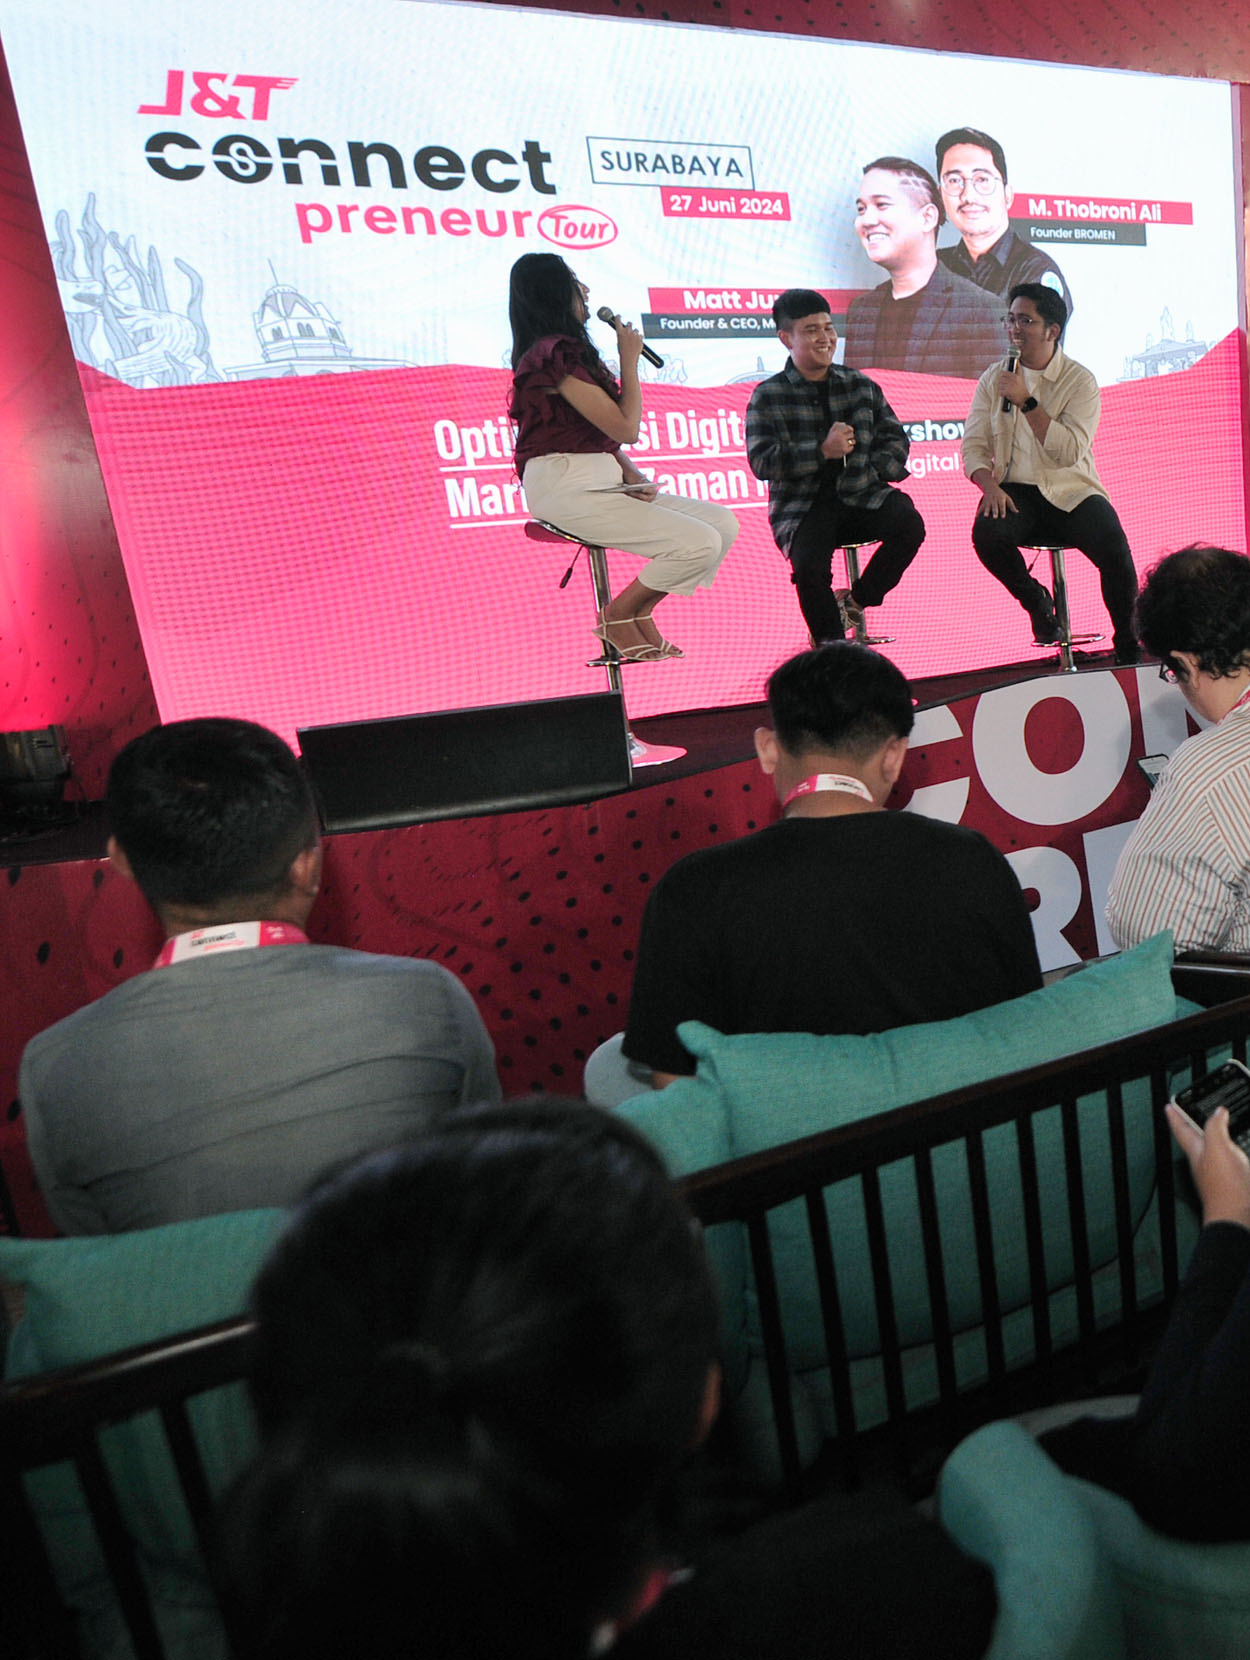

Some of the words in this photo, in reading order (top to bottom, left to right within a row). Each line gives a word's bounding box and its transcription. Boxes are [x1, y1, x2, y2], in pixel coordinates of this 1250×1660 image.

[137, 69, 299, 121] J&T
[145, 131, 557, 195] connect
[601, 150, 744, 178] SURABAYA
[669, 195, 692, 211] 27
[699, 197, 736, 213] Juni
[740, 198, 784, 215] 2024
[1029, 199, 1052, 216] M.
[1054, 200, 1136, 220] Thobroni
[1139, 203, 1162, 221] Ali
[295, 203, 532, 244] preneur
[546, 214, 610, 241] Tour
[1030, 227, 1072, 239] Founder
[1074, 229, 1116, 240] BROMEN
[683, 290, 741, 310] Matt
[745, 291, 781, 310] Ju
[660, 318, 714, 330] Founder
[717, 318, 728, 330] &
[730, 318, 761, 331] CEO,
